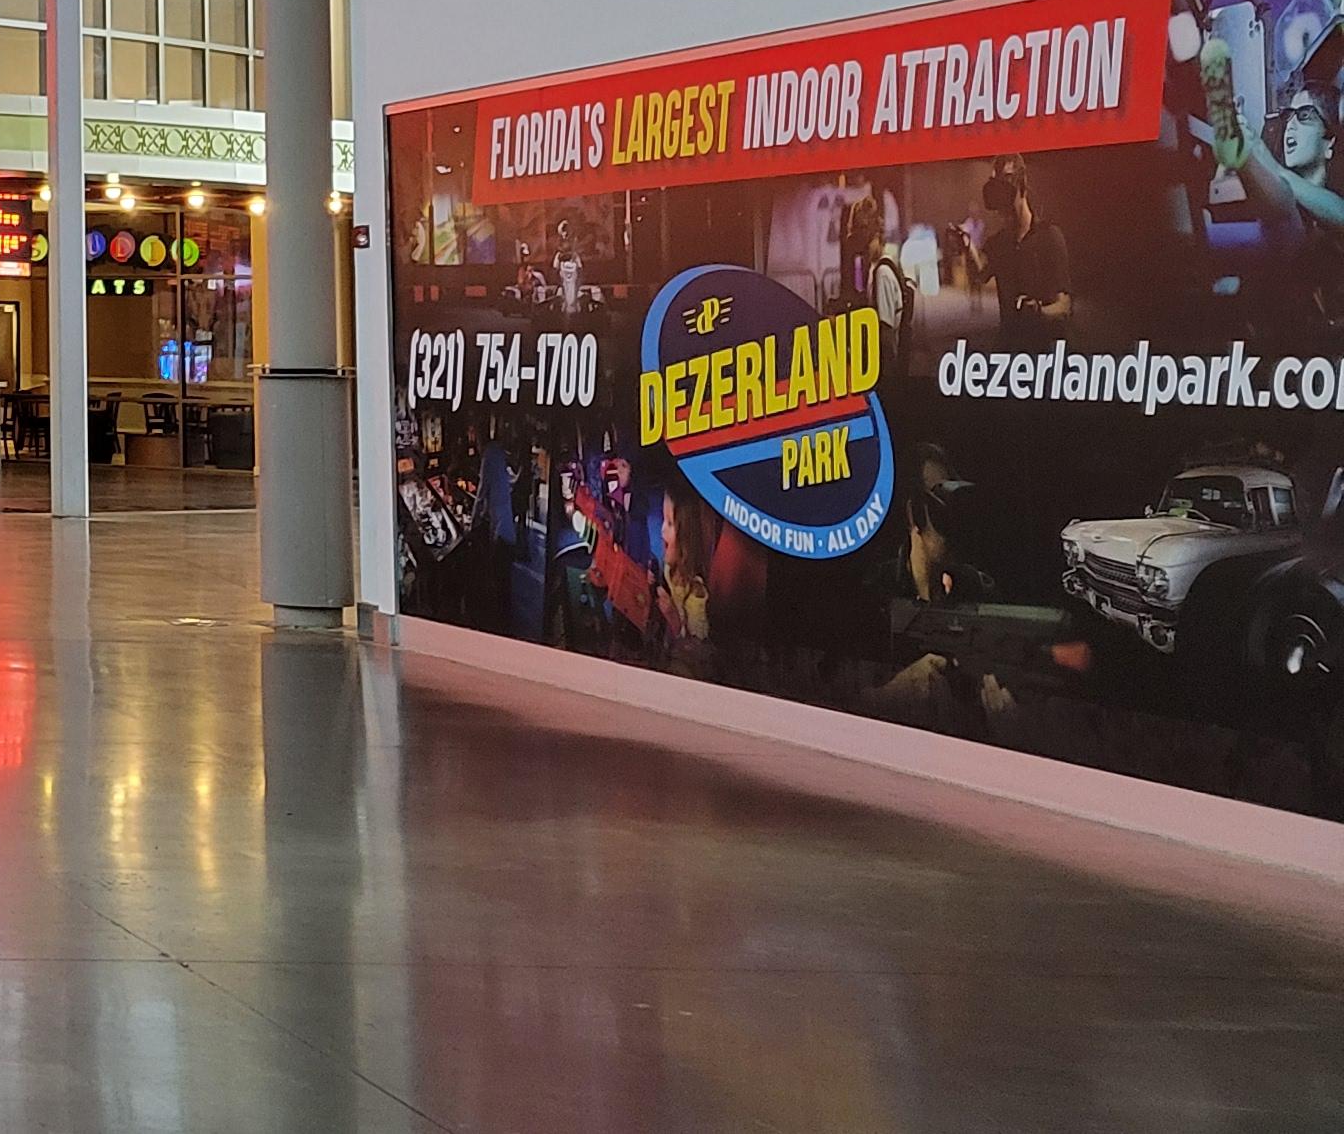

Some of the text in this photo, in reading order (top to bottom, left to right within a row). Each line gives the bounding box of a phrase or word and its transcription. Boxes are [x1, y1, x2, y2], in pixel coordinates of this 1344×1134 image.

[489, 17, 1126, 180] FLORIDA'S LARGEST INDOOR ATTRACTION
[90, 279, 147, 295] ATS
[408, 328, 597, 412] (321) 754-1700
[639, 307, 880, 447] DEZERLAND
[938, 339, 1344, 416] dezerlandpark.co
[782, 426, 851, 490] PARK
[724, 494, 884, 554] INDOOR FUN ALL DAY
